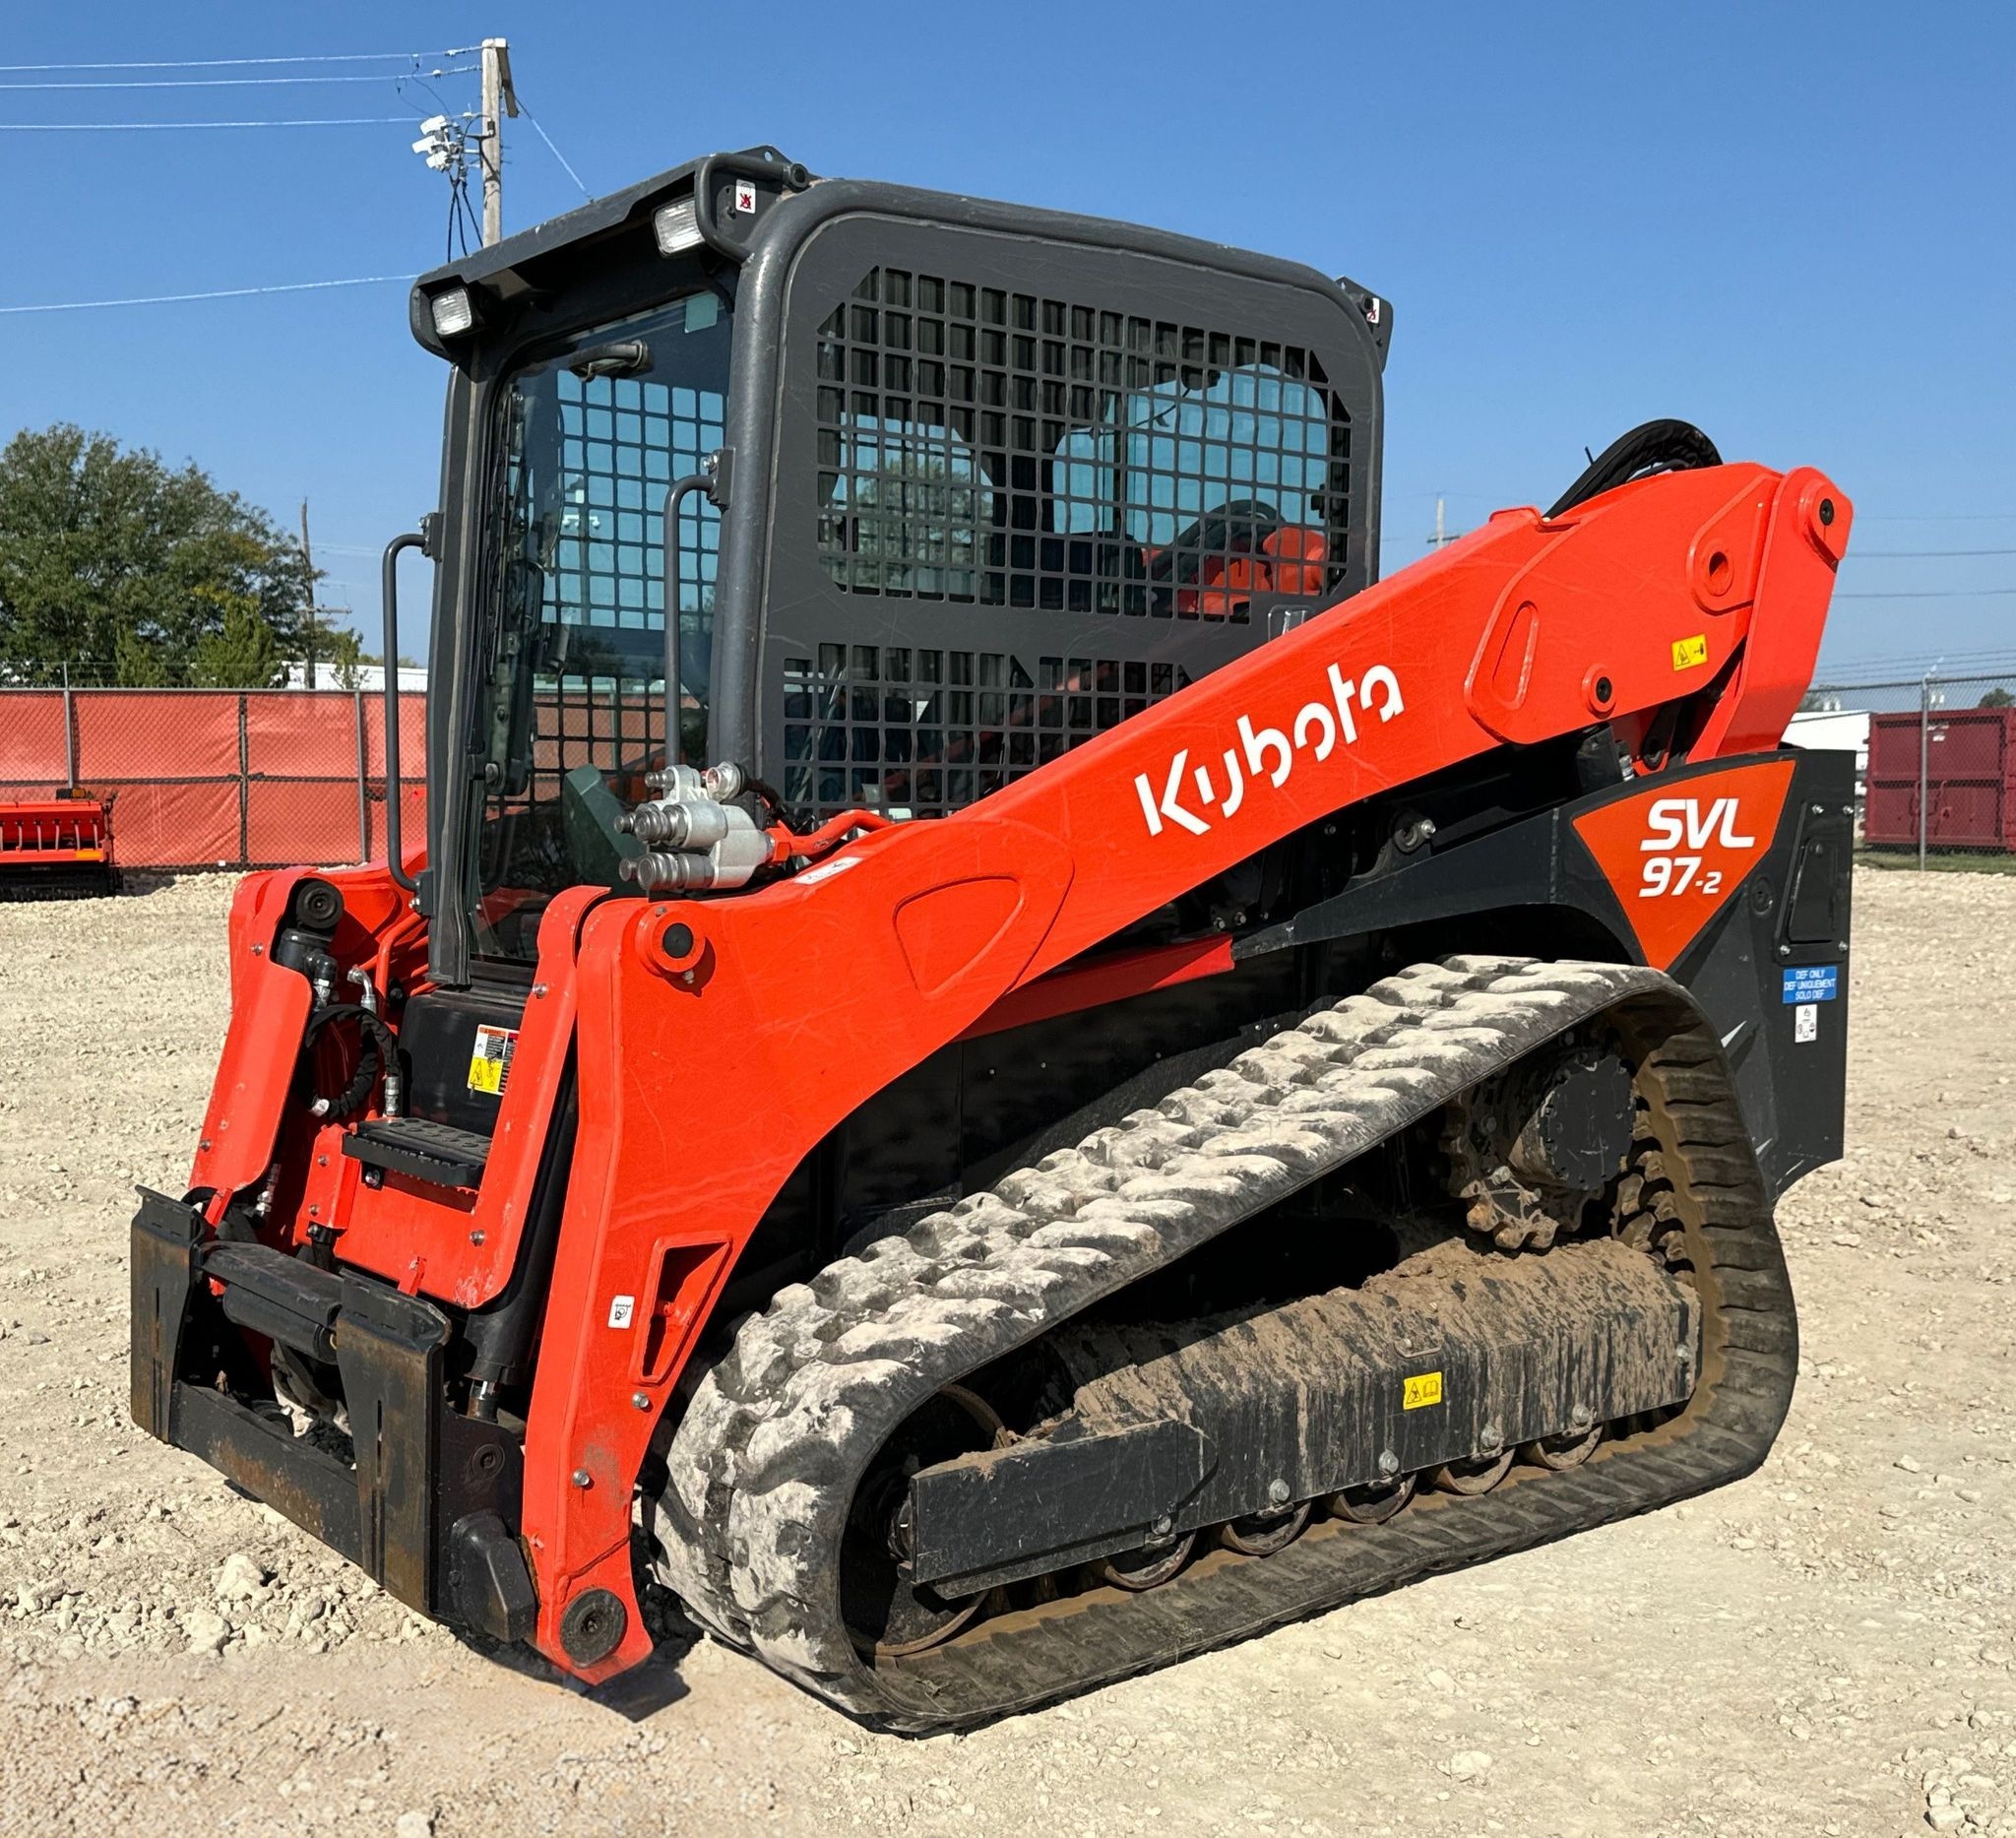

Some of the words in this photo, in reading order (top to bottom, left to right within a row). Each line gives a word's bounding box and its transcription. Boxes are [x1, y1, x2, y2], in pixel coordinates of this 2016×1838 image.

[1134, 662, 1405, 837] Kubota
[1640, 797, 1755, 852] SVL
[1638, 856, 1723, 898] 97-2
[1784, 981, 1796, 990] DEF
[1796, 970, 1809, 980] DEF
[1809, 969, 1825, 979] ONLY
[1796, 990, 1811, 1000] SOLO
[1812, 989, 1825, 999] DEF
